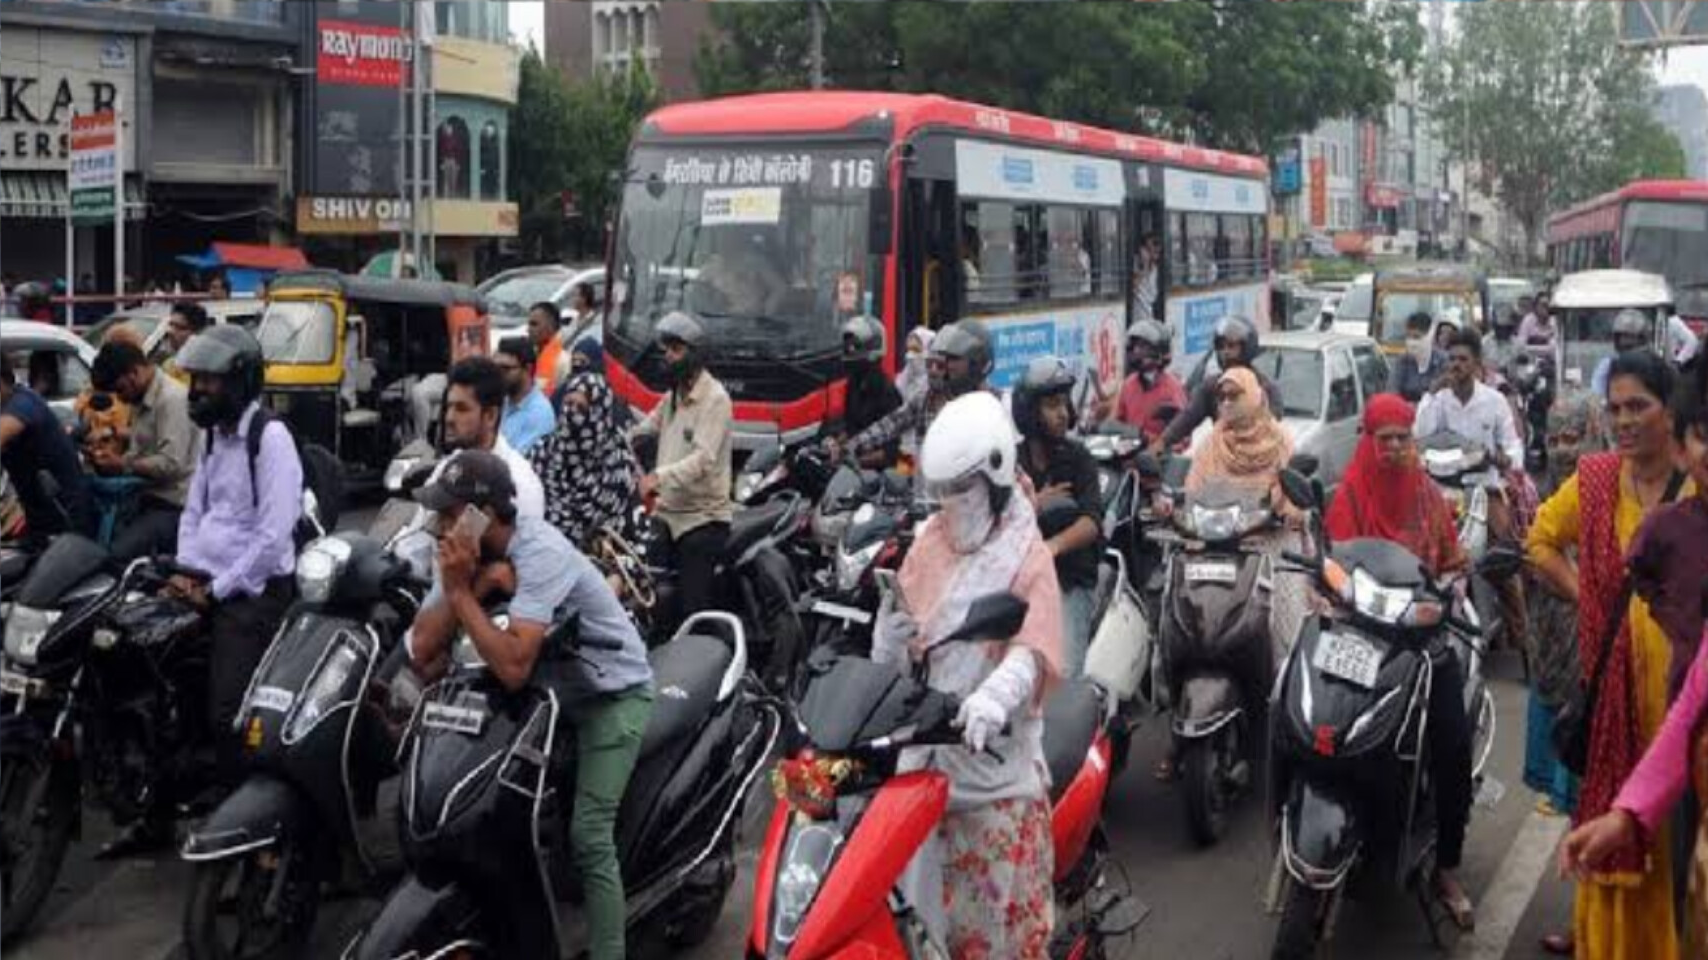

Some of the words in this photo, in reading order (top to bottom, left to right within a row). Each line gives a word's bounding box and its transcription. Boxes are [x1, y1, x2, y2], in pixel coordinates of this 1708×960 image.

[0, 131, 69, 159] ERS
[830, 158, 875, 188] 116
[312, 196, 372, 219] SHIV
